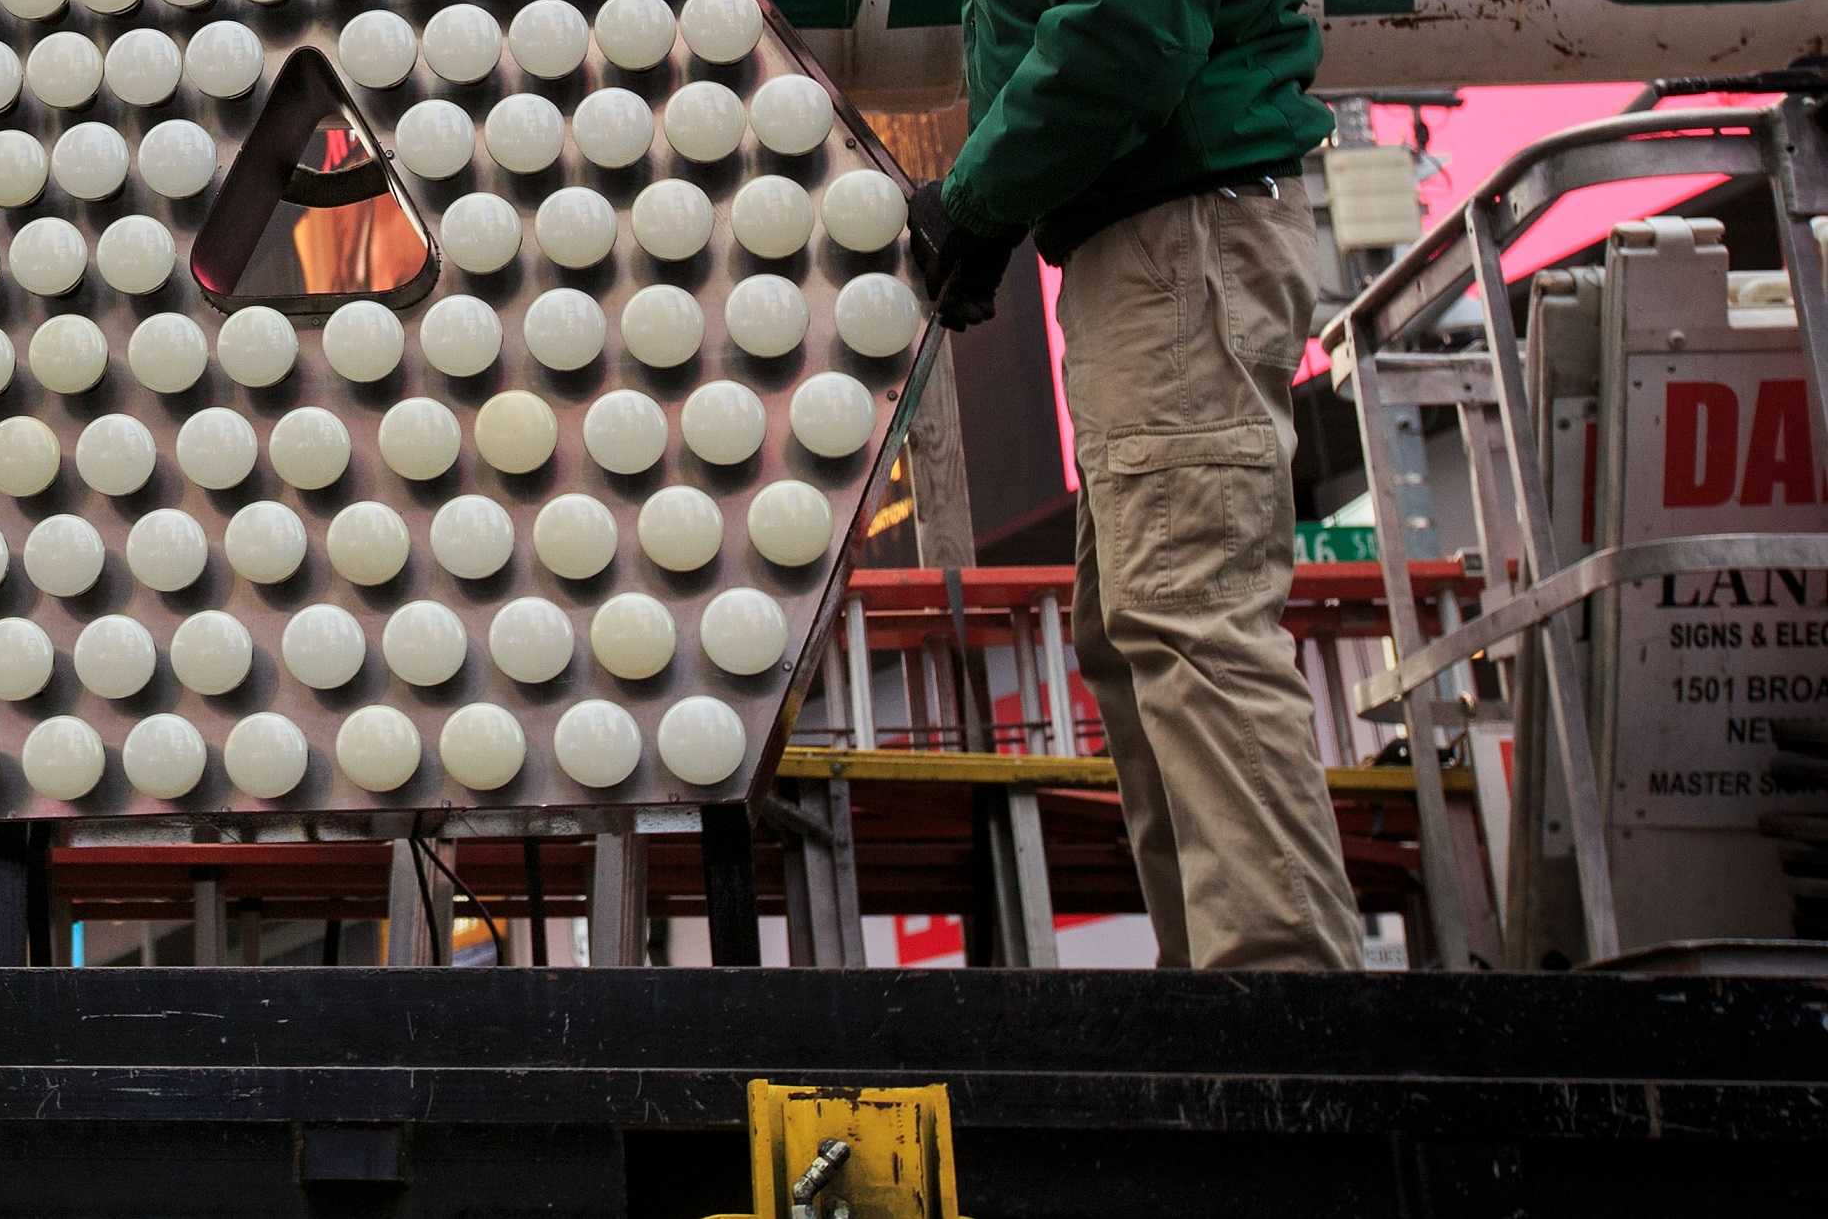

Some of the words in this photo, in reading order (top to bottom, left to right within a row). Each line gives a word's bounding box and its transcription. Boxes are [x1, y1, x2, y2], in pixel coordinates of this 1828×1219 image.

[1663, 379, 1828, 509] DA
[1656, 568, 1828, 608] LAN
[1670, 622, 1743, 649] SIGNS
[1750, 622, 1769, 649] &
[1672, 675, 1734, 703] 1501
[1648, 772, 1752, 798] MASTER
